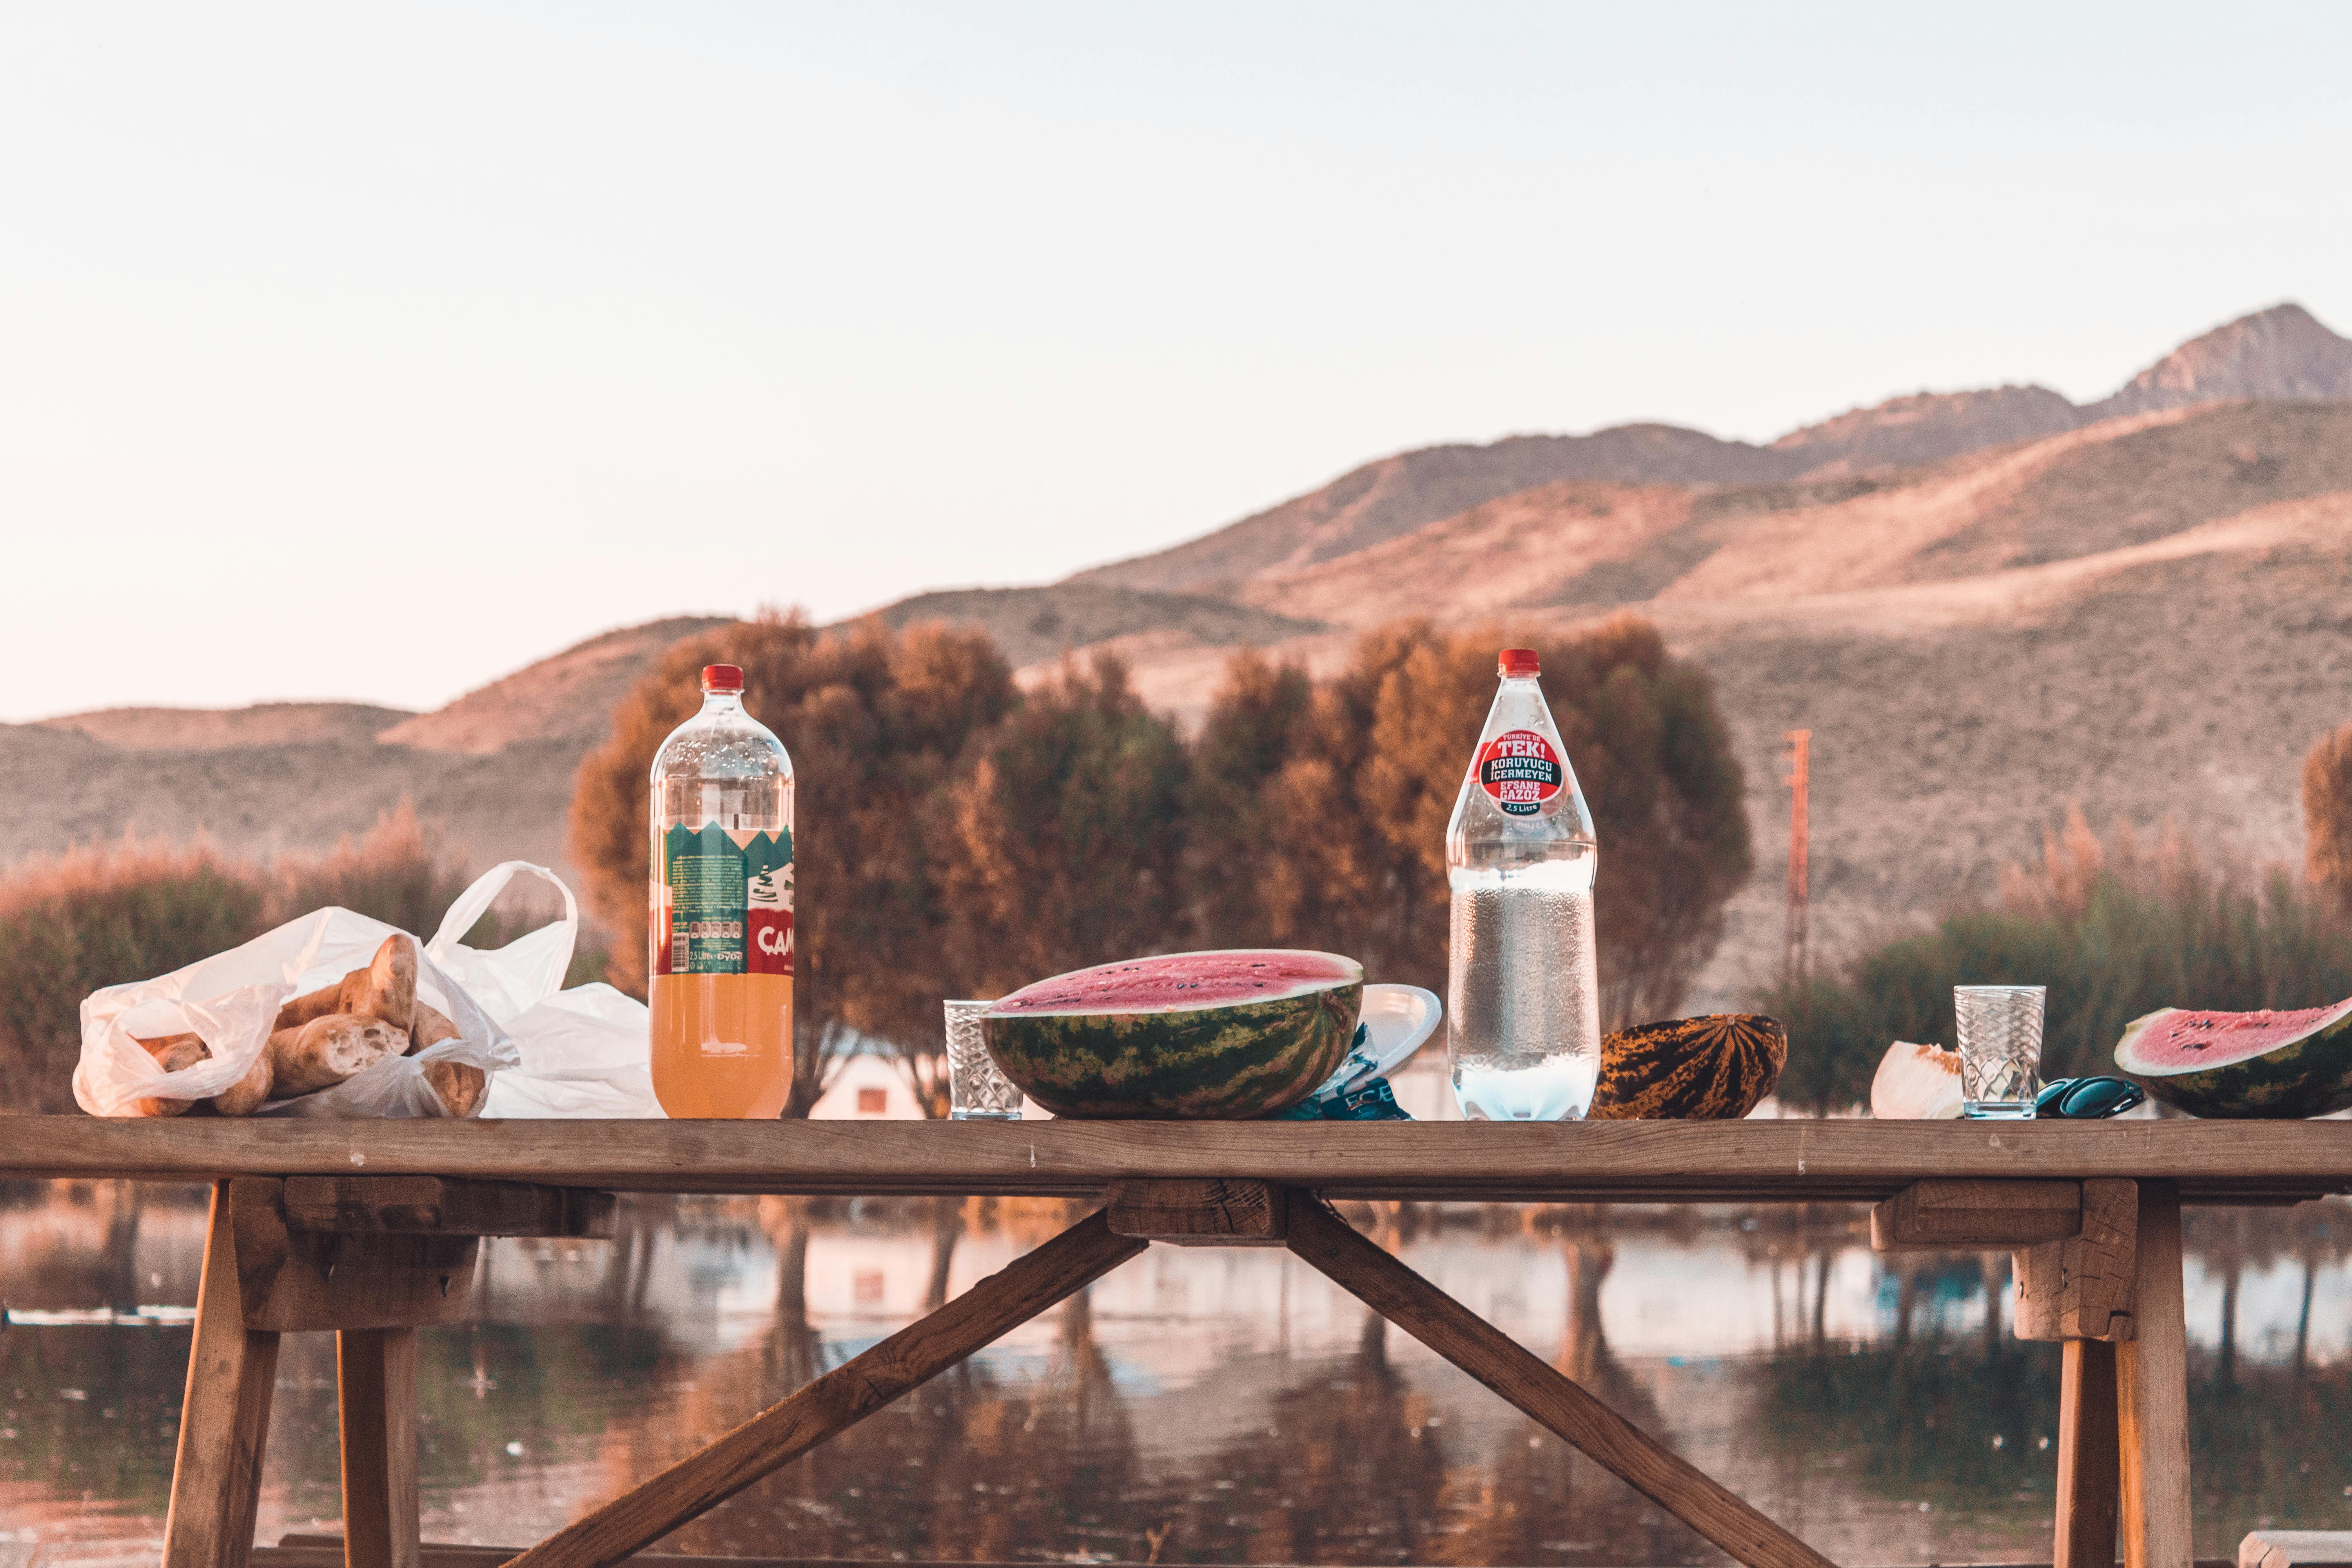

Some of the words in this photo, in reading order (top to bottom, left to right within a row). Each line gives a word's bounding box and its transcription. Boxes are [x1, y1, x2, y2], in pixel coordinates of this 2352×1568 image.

[1497, 740, 1545, 759] TEK!
[1491, 758, 1552, 771] KORUYUCU
[1491, 769, 1552, 782] İÇERMEYEN
[1501, 781, 1540, 790] EFSANE
[1500, 789, 1540, 801] GAZOZ
